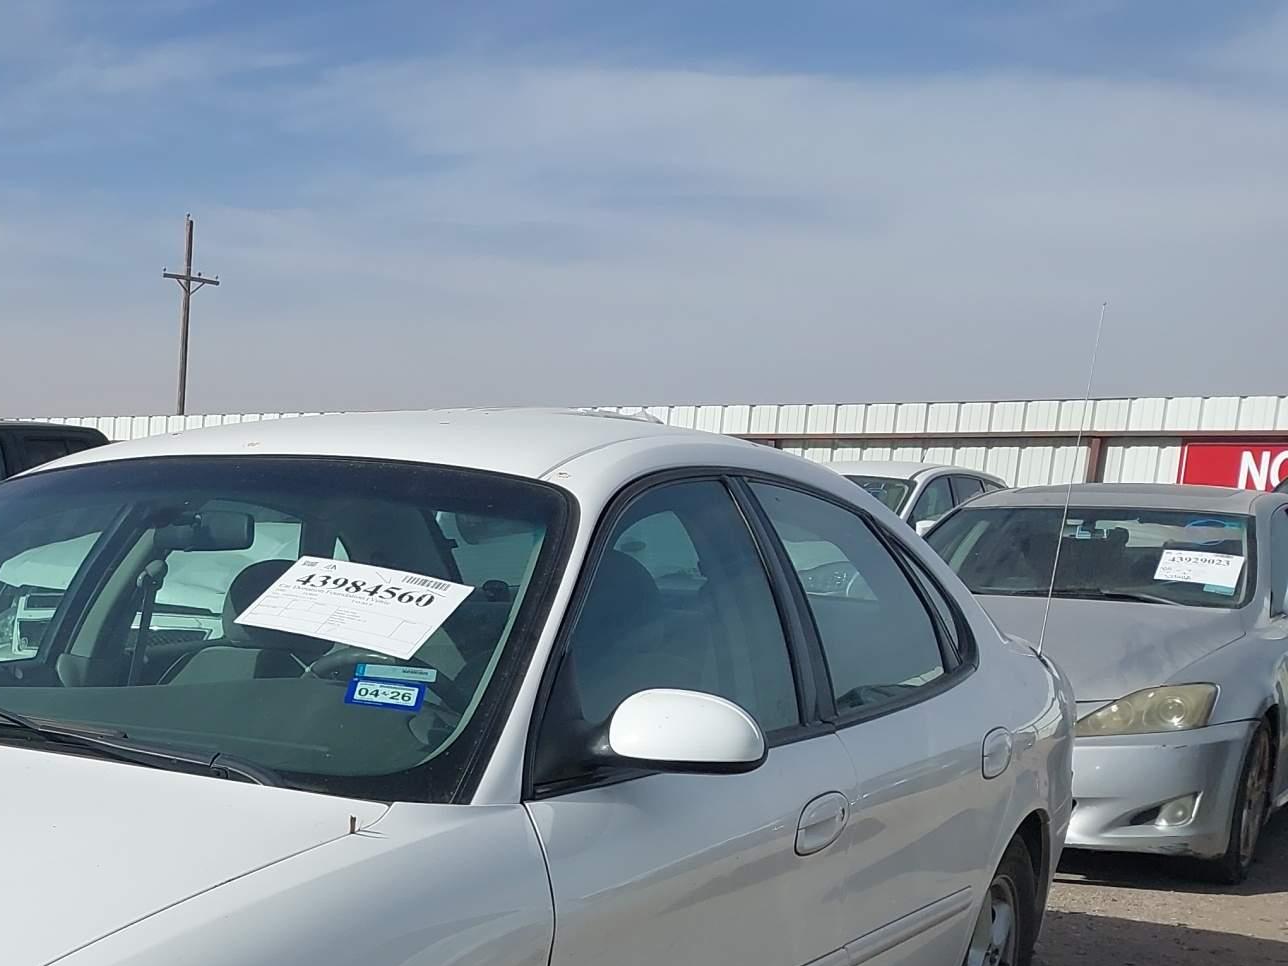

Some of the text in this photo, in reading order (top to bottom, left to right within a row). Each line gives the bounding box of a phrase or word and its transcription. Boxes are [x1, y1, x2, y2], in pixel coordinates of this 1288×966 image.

[1168, 556, 1231, 567] 43929023
[296, 573, 435, 607] 43984560
[358, 687, 380, 698] 04
[389, 690, 412, 702] 26
